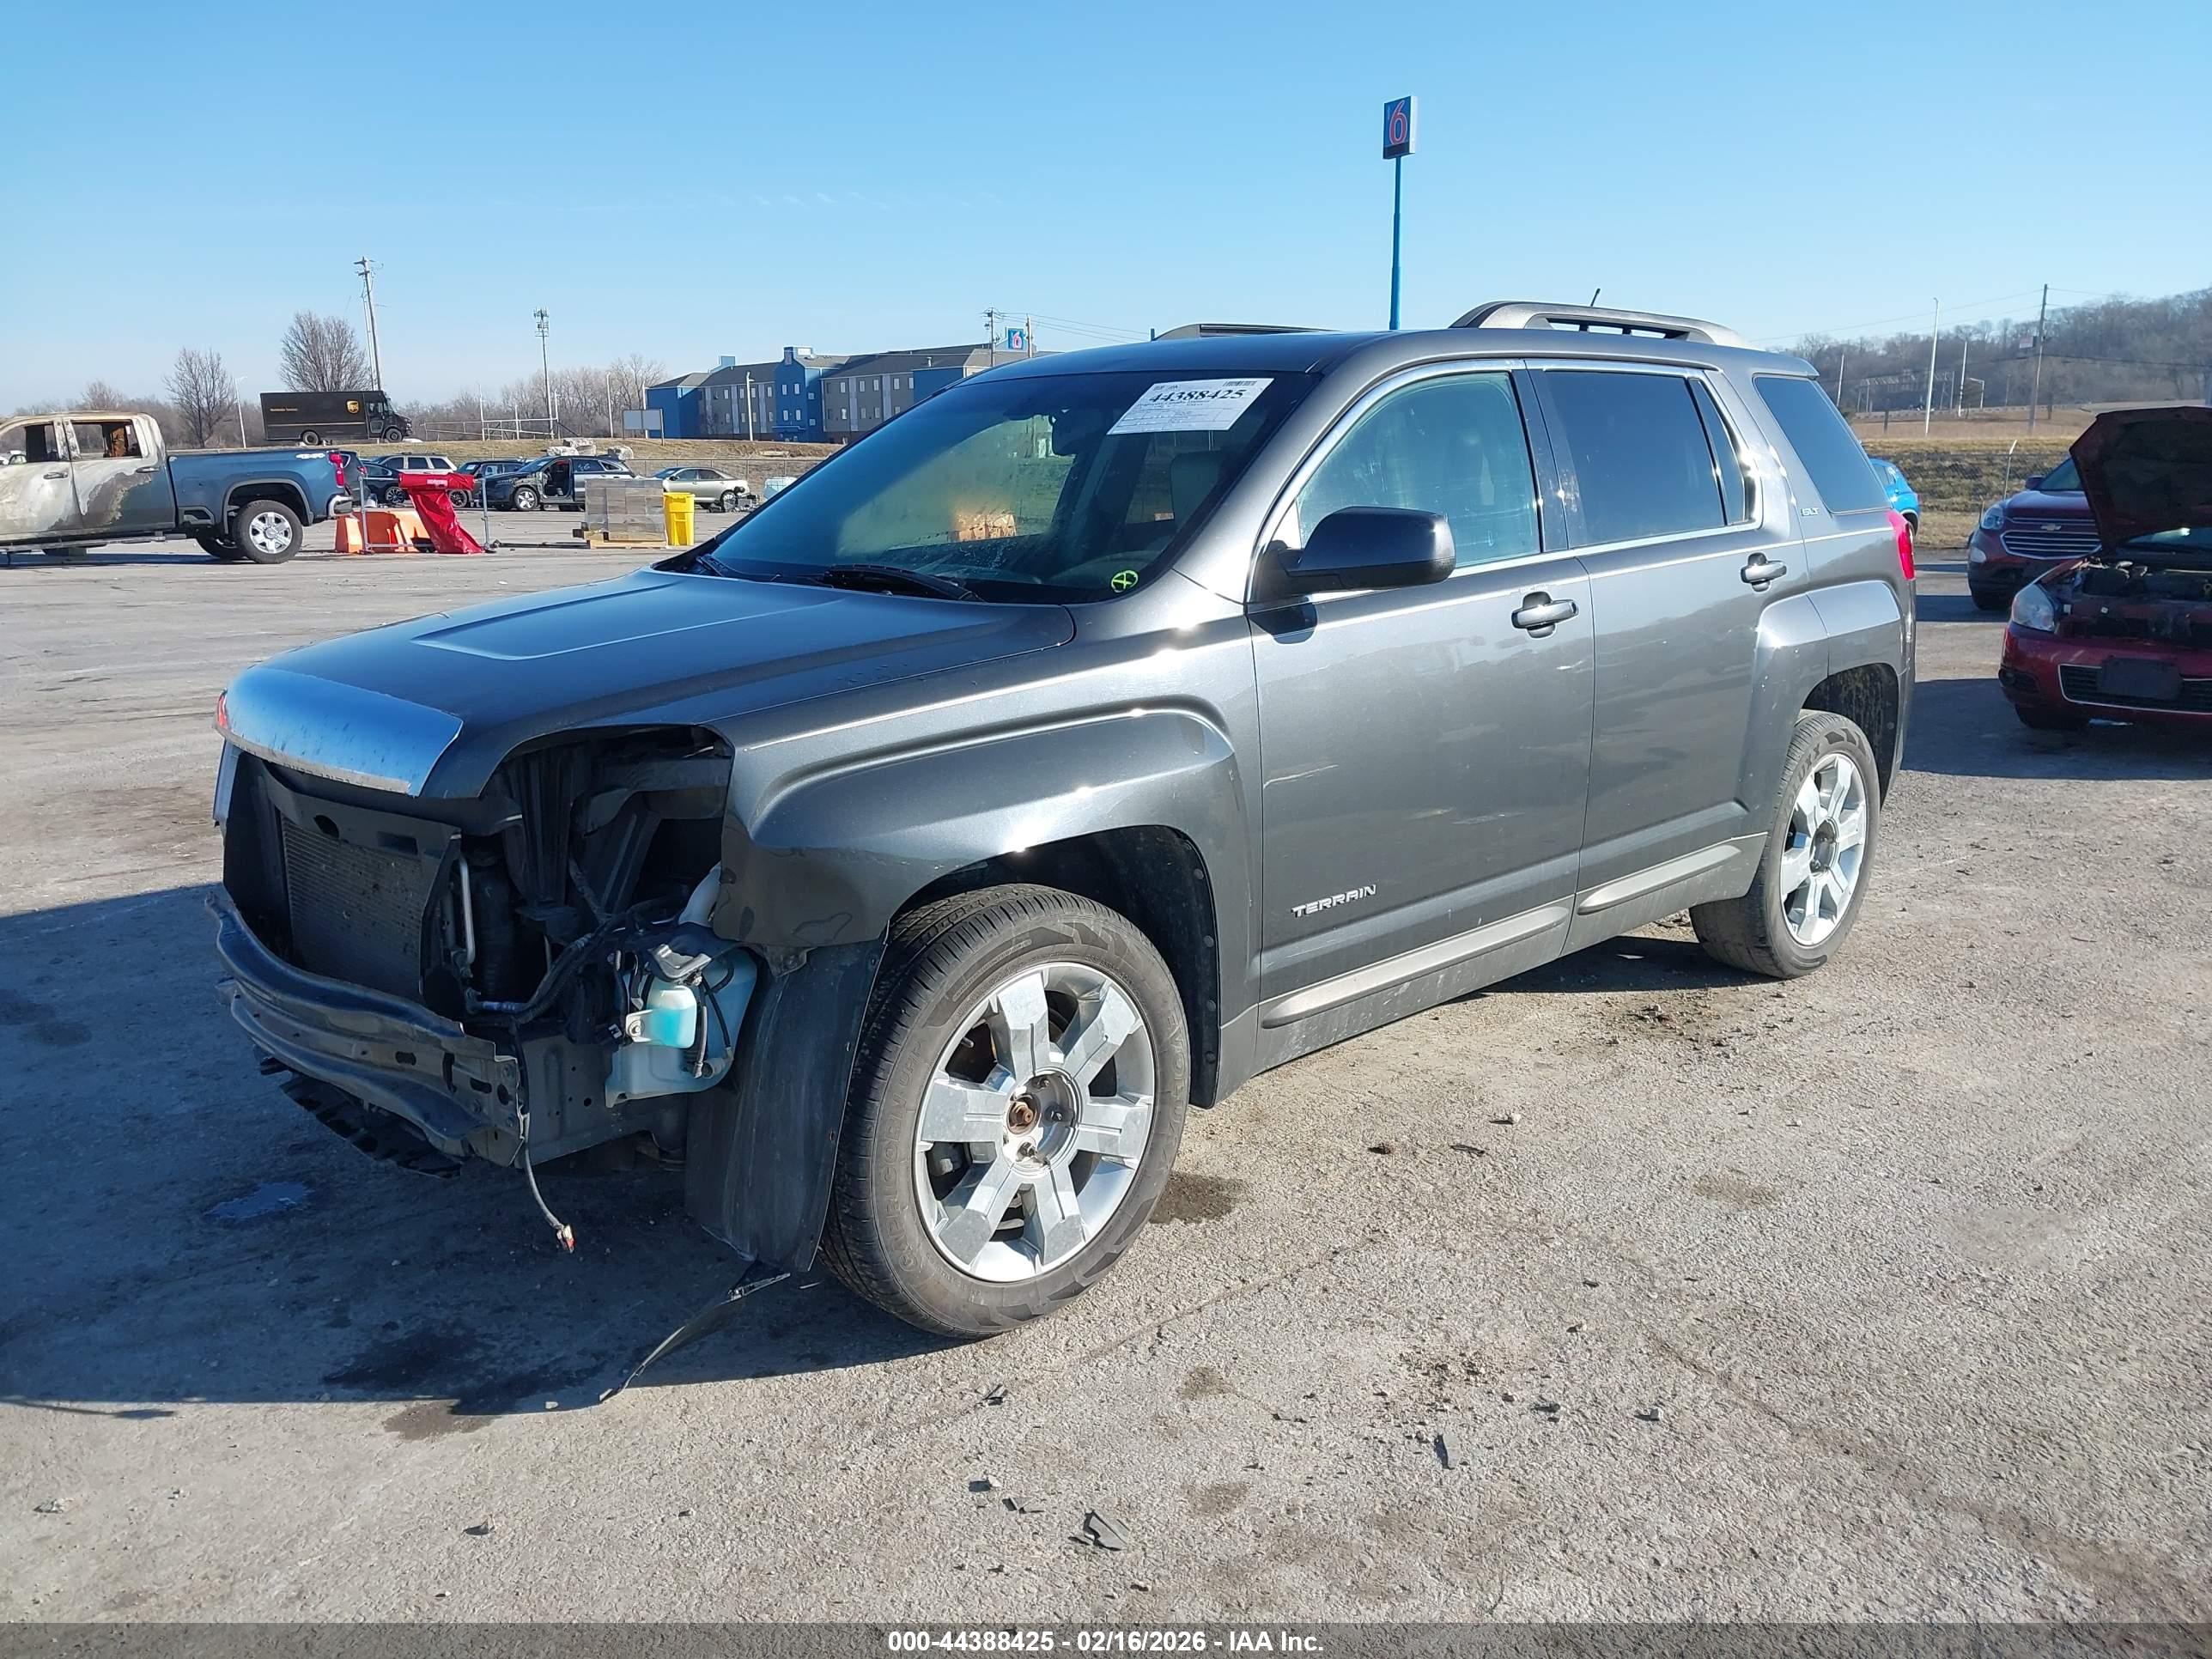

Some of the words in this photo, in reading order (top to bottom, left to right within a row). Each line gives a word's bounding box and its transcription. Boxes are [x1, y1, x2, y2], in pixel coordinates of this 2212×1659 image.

[1389, 99, 1408, 145] 6
[1012, 331, 1023, 349] 6
[1147, 389, 1249, 404] 44388425
[1801, 507, 1820, 517] SLT
[1291, 884, 1376, 917] TERRAIN
